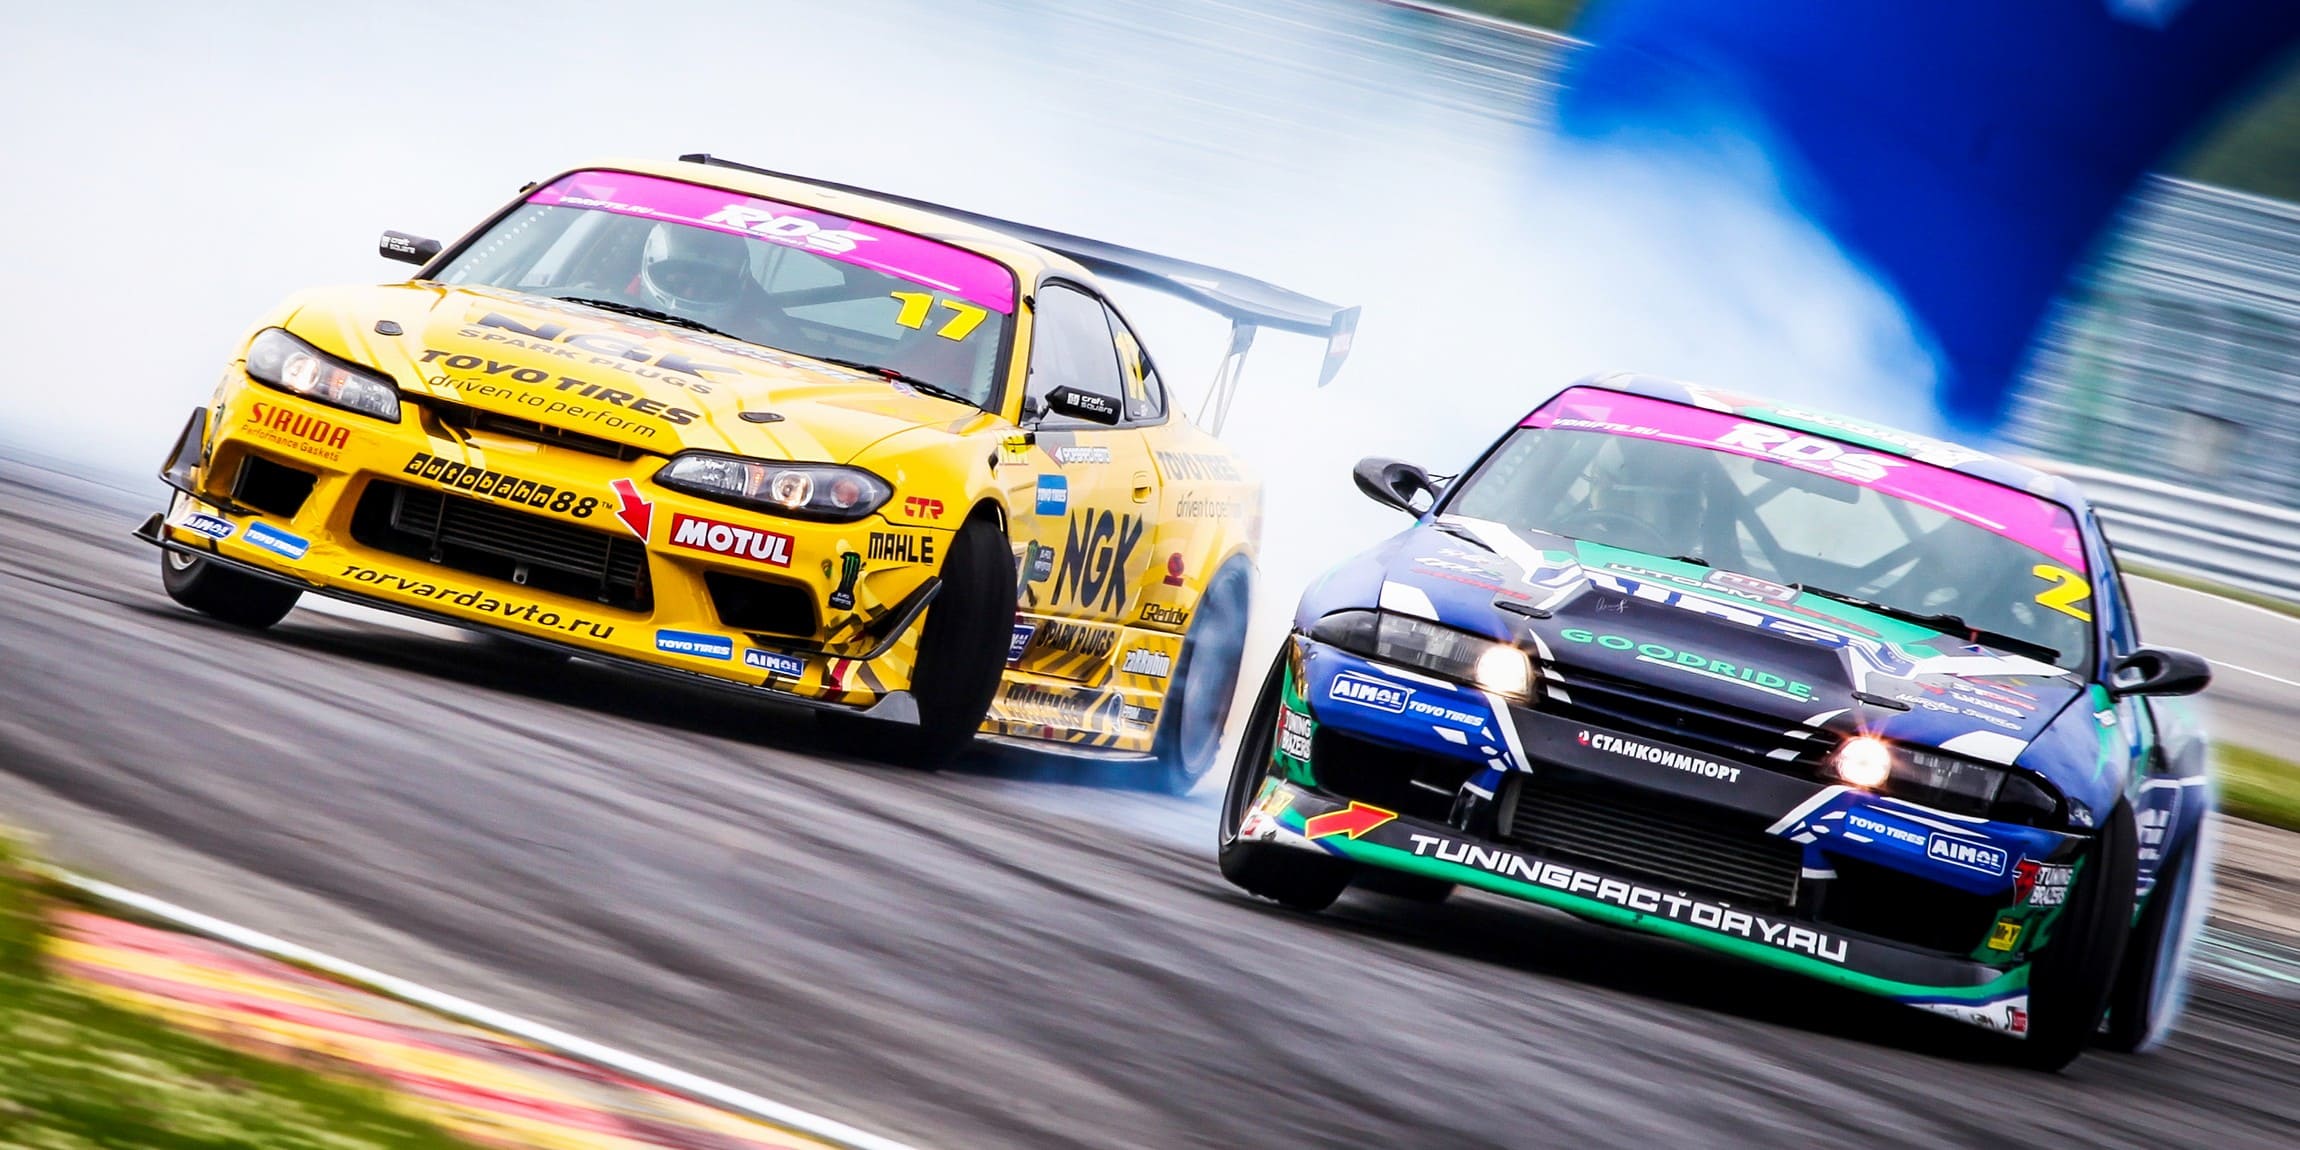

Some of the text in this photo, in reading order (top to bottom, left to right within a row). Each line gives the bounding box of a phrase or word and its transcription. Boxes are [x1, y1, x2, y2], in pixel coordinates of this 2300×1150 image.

[702, 204, 878, 253] RDS
[891, 291, 988, 341] 17
[456, 328, 586, 359] SPARK
[589, 356, 712, 394] PLUGS
[478, 312, 740, 382] NGK
[419, 349, 701, 427] TOYO TIRES
[429, 375, 657, 438] driven to perform
[242, 424, 340, 462] Performance Gaskets
[247, 402, 351, 449] SIRUDA
[1716, 423, 1909, 480] RDS
[674, 519, 790, 565] MOTUL
[868, 532, 933, 564] MAHLE
[1051, 508, 1143, 616] NGK
[2032, 563, 2093, 622] 2
[657, 639, 730, 656] TOYO TIRES
[746, 653, 801, 673] AIMOL
[1036, 619, 1079, 652] SPARK
[1075, 626, 1115, 658] PLUGS
[1561, 628, 1812, 698] GOODRIDE
[1332, 680, 1405, 706] AIMOL
[1409, 701, 1484, 727] TOYO TIRES
[1591, 733, 1740, 783] СТАНКОИМПОРТ
[1850, 815, 1926, 846] TOYO TIRES
[1932, 840, 2002, 868] AIMOL
[1410, 834, 1848, 963] TUNINGFACTORY.RU
